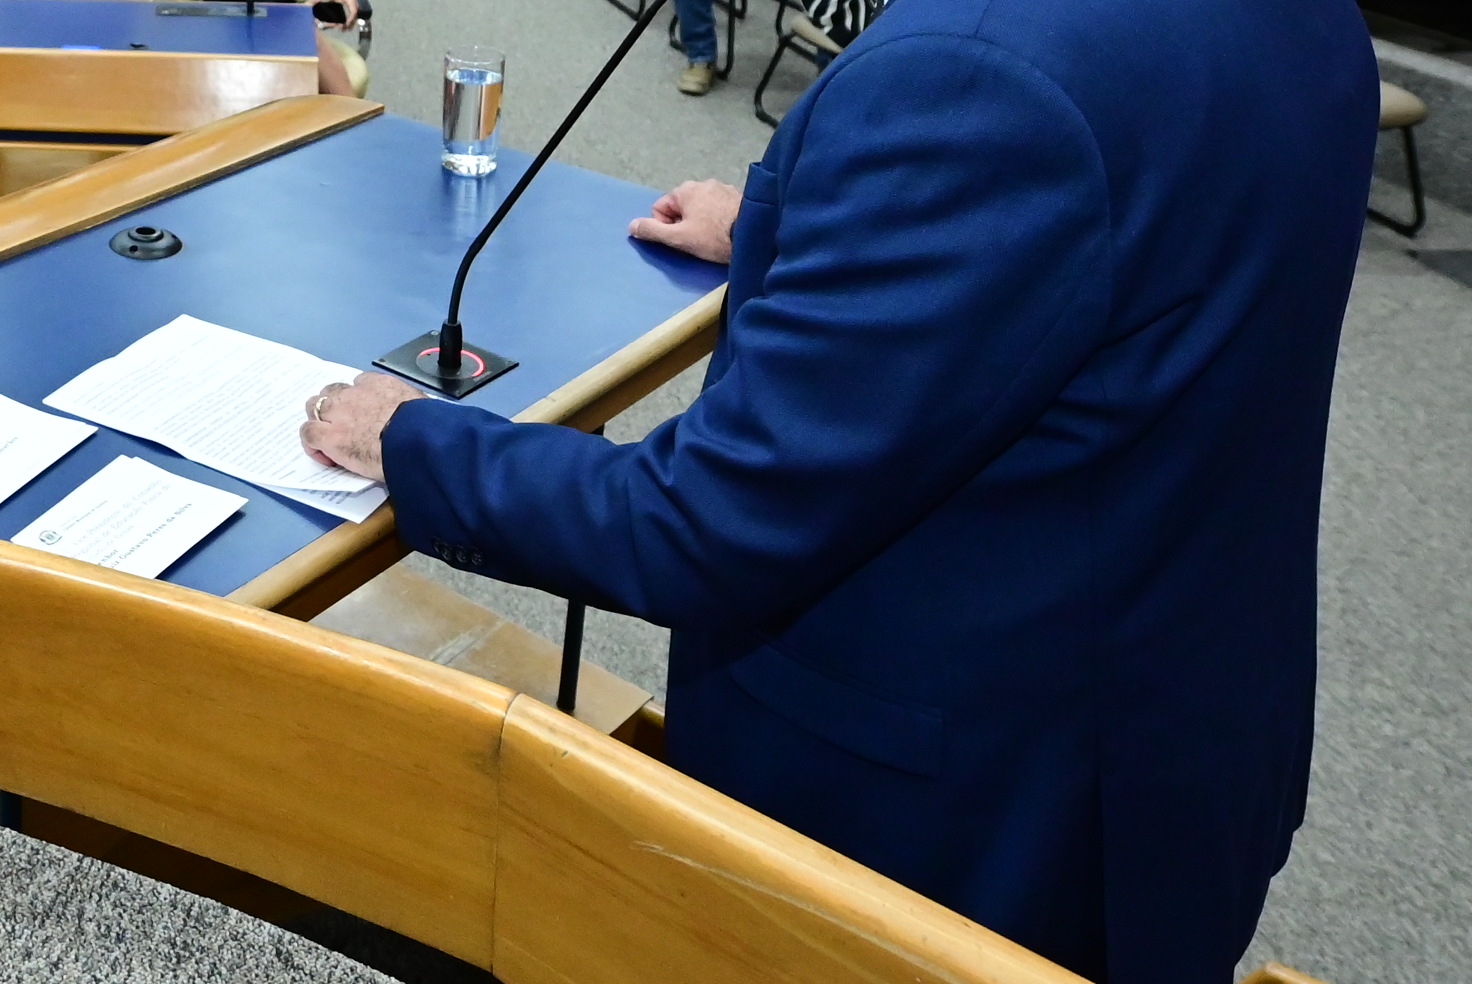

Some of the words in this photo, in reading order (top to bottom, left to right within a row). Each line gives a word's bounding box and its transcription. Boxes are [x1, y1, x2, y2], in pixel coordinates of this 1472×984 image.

[119, 537, 149, 560] Gustavo
[174, 502, 193, 516] Silva
[98, 549, 119, 566] enhor
